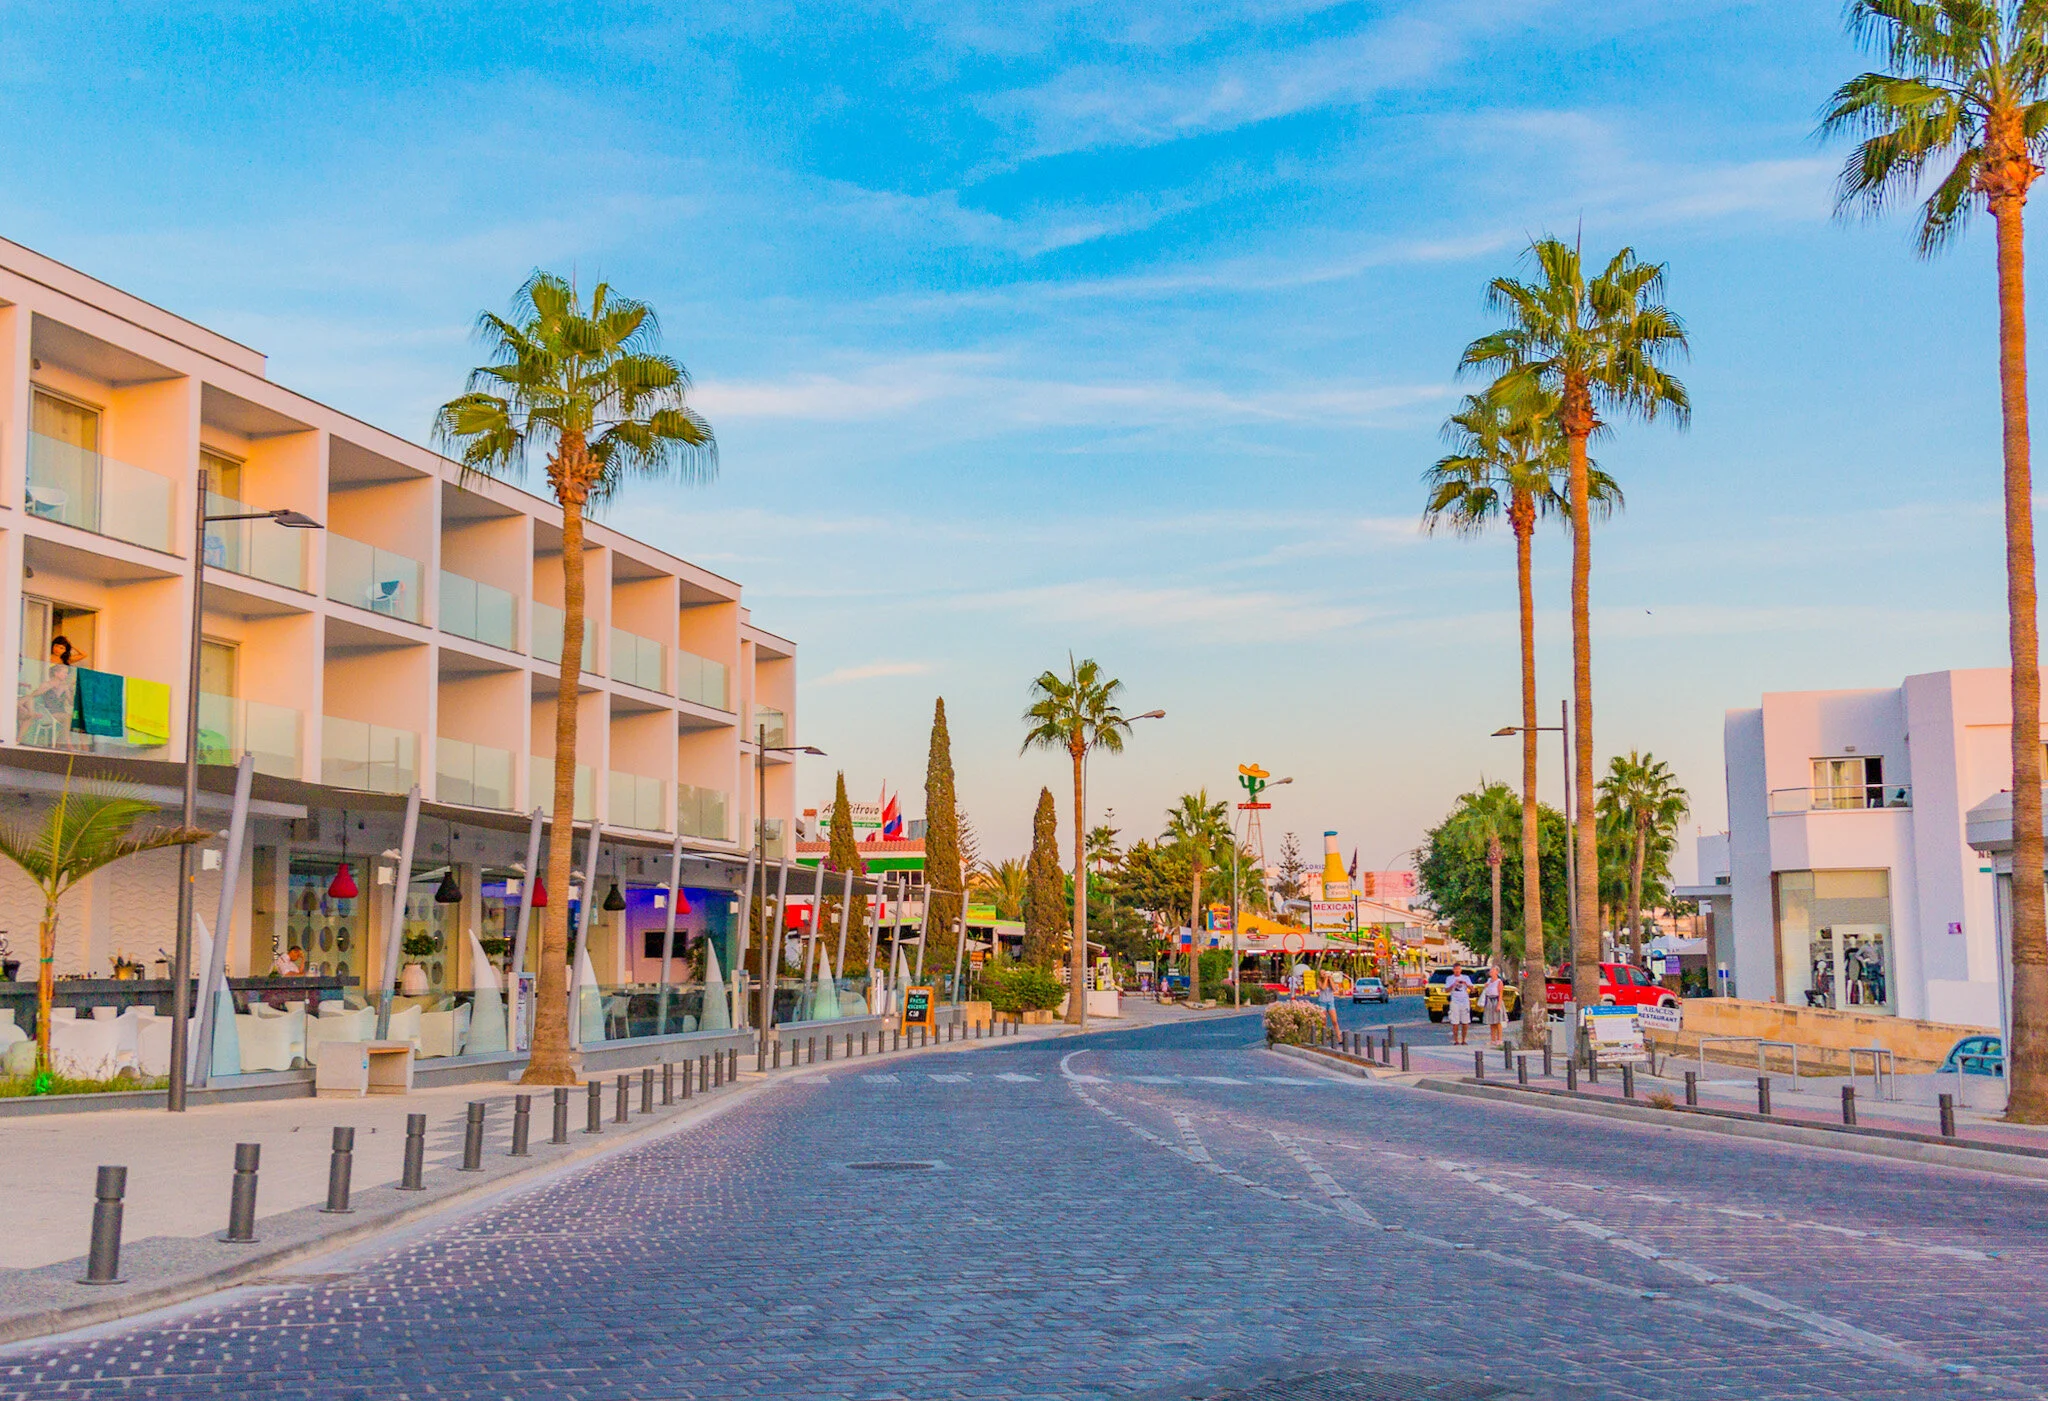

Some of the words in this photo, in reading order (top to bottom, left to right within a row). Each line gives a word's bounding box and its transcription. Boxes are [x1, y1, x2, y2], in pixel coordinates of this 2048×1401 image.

[1313, 903, 1354, 911] MEXICAN
[1643, 1006, 1674, 1015] ABACUS
[1638, 1012, 1678, 1022] RESTAURANT
